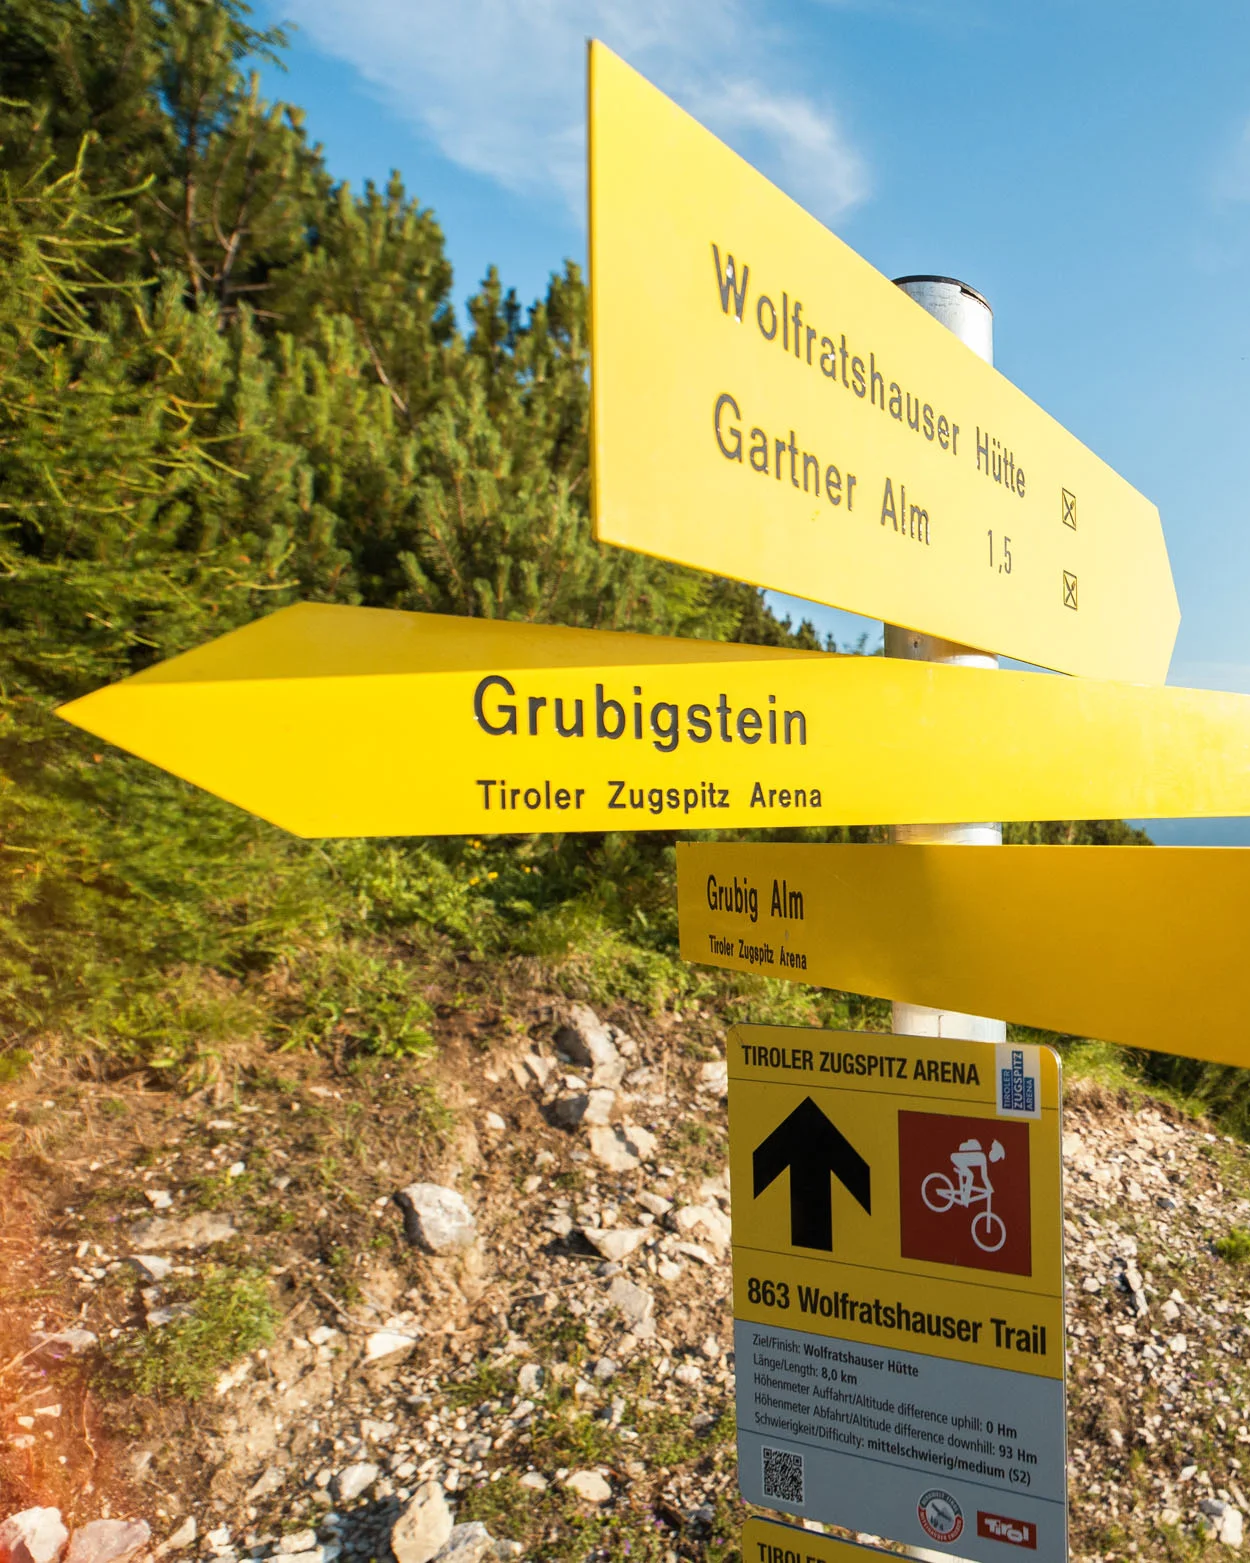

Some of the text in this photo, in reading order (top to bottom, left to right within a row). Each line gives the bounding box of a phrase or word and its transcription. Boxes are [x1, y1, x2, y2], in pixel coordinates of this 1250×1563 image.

[711, 243, 1026, 498] Wolfratshauser Hütte
[713, 392, 1012, 574] Gartner Alm 1,5
[473, 674, 807, 753] Grubigstein
[476, 780, 822, 815] Tiroler Zugspitz Arena
[707, 874, 804, 923] Grubig Alm
[708, 934, 808, 970] Tiroler Zugspitz Arena
[741, 1044, 980, 1086] TIROLER ZUGSPITZ ARENA
[1013, 1052, 1023, 1109] ZUGSPITZ
[1003, 1070, 1011, 1108] TIROLER
[1025, 1079, 1033, 1110] ARENA
[747, 1277, 1047, 1356] 863 Wolfratshauser Trail
[752, 1333, 919, 1378] Ziel/Finish: Wolfratshauser Hütte
[753, 1352, 858, 1385] Länge/Length: 8,0 km
[753, 1372, 1018, 1439] Höhenmeter Auffahrt/Altitude difference uphill: 0 Hm
[754, 1391, 1038, 1465] Höhenmeter Abfahrt/Altitude difference downhill: 93 Hm
[754, 1411, 1031, 1487] Schwierigkeit/Difficulty: mittelschwierig/medium (S2)
[756, 1541, 827, 1563] TIROL
[984, 1517, 1030, 1543] Tirol
